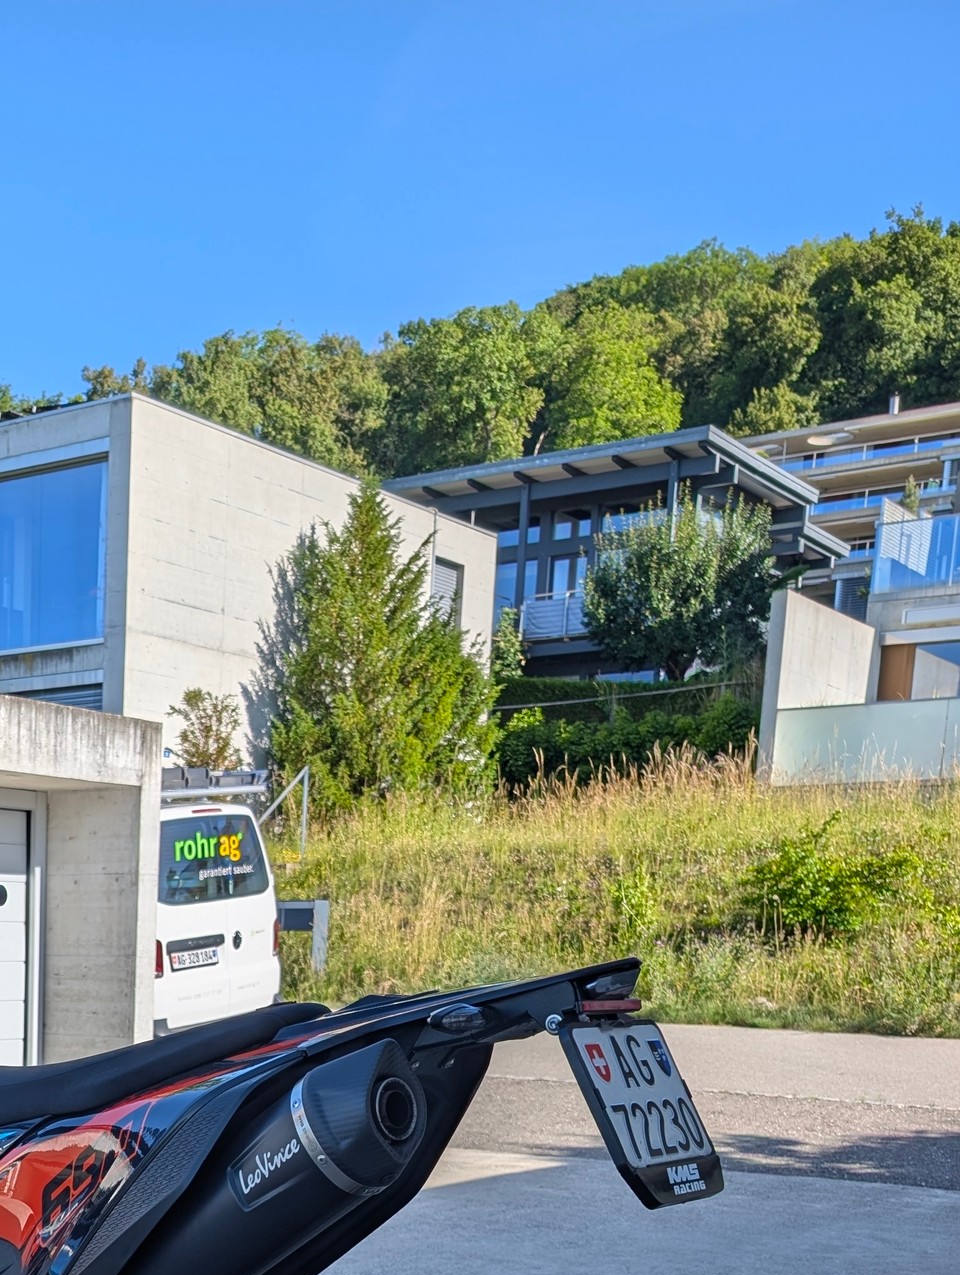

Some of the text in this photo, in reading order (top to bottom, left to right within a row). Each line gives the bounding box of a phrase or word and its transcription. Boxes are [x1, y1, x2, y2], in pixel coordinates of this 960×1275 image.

[198, 866, 232, 880] garantiert
[609, 1034, 655, 1089] AG
[610, 1096, 705, 1161] 72230
[239, 1138, 300, 1195] LeoVince
[666, 1163, 701, 1185] KMS
